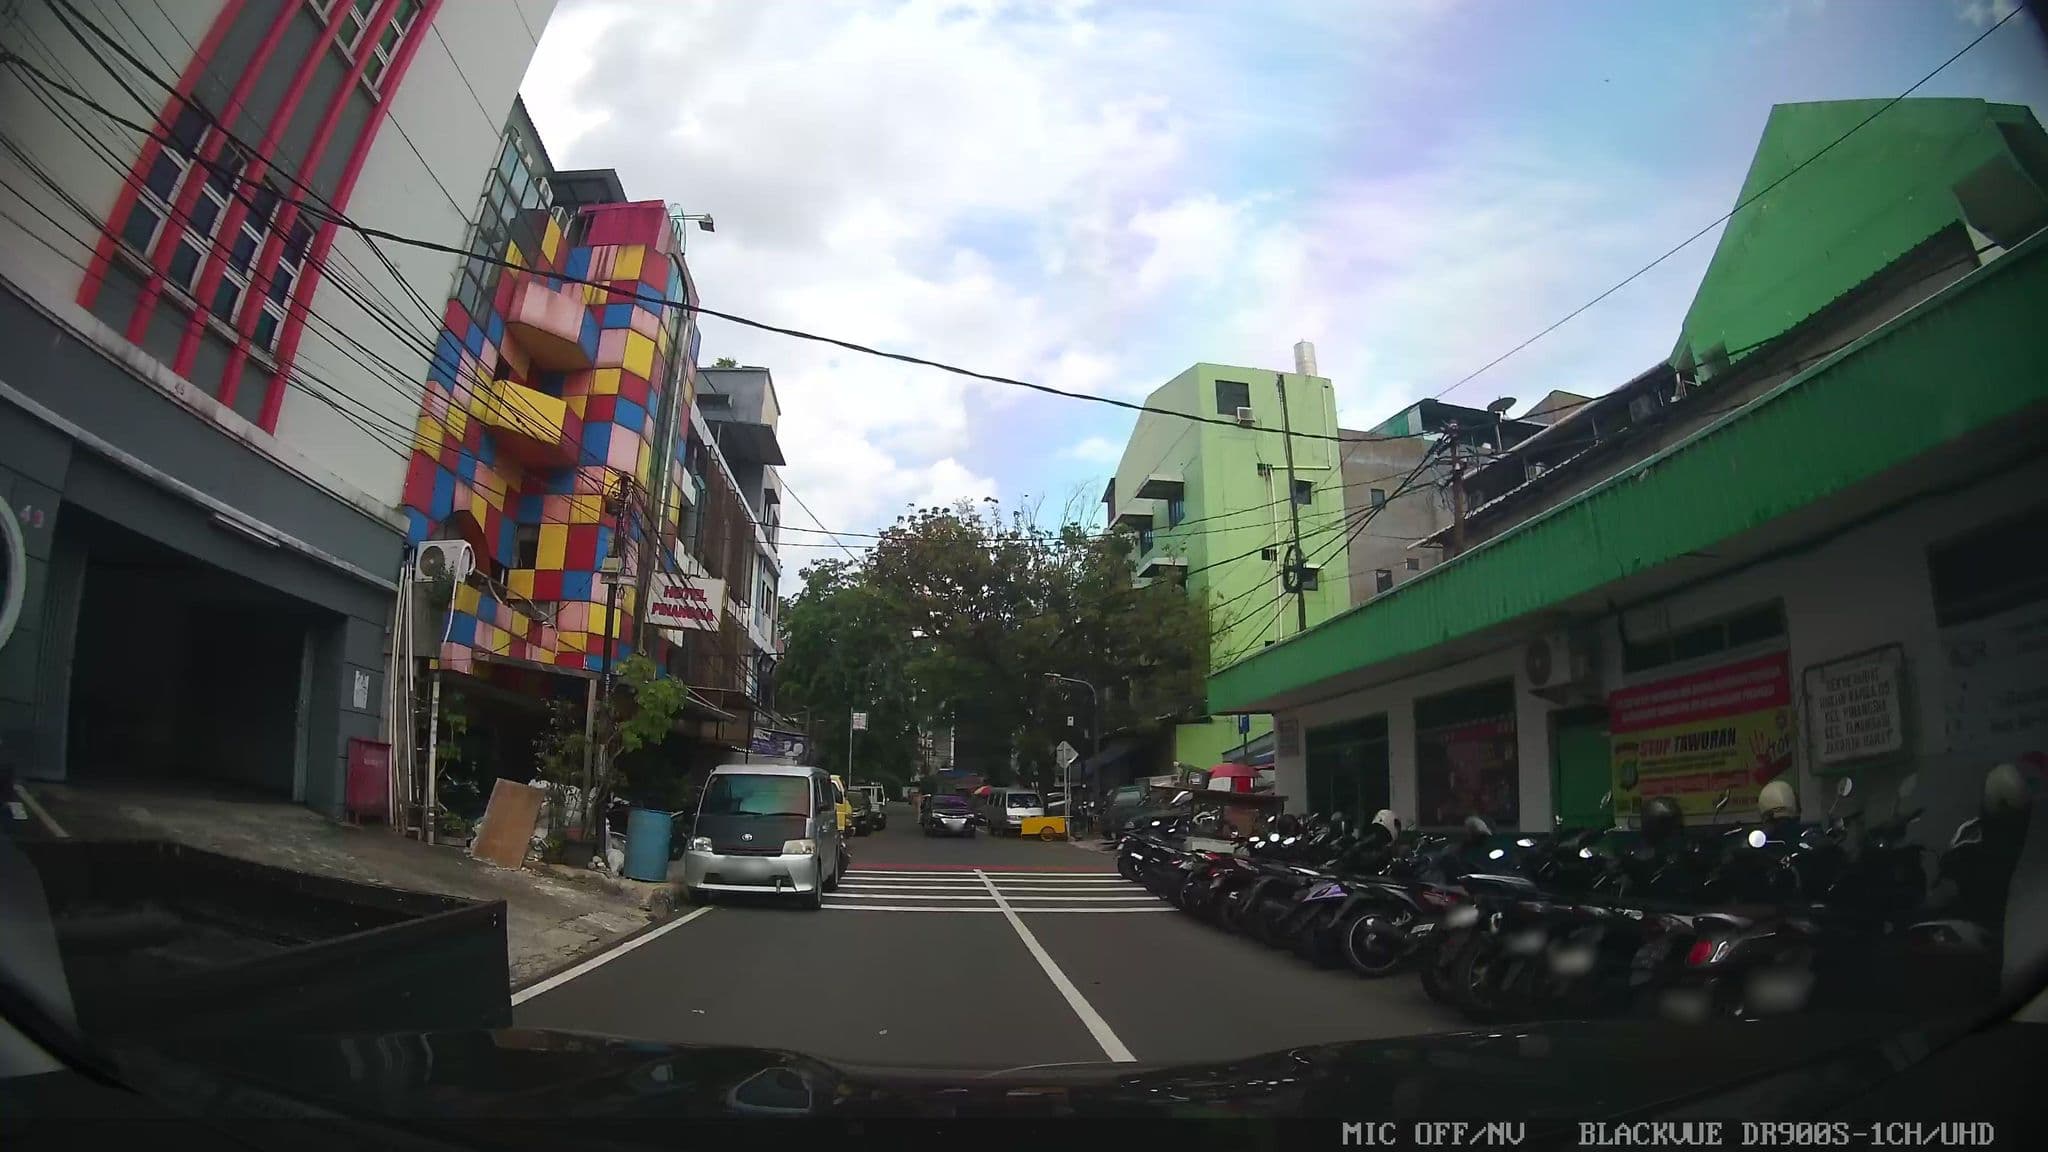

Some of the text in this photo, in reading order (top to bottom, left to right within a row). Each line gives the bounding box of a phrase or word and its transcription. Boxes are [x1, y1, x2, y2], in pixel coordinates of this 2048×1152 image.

[664, 585, 706, 602] HOTEL
[1638, 738, 1672, 758] STOP
[1674, 727, 1736, 753] TAWURAN
